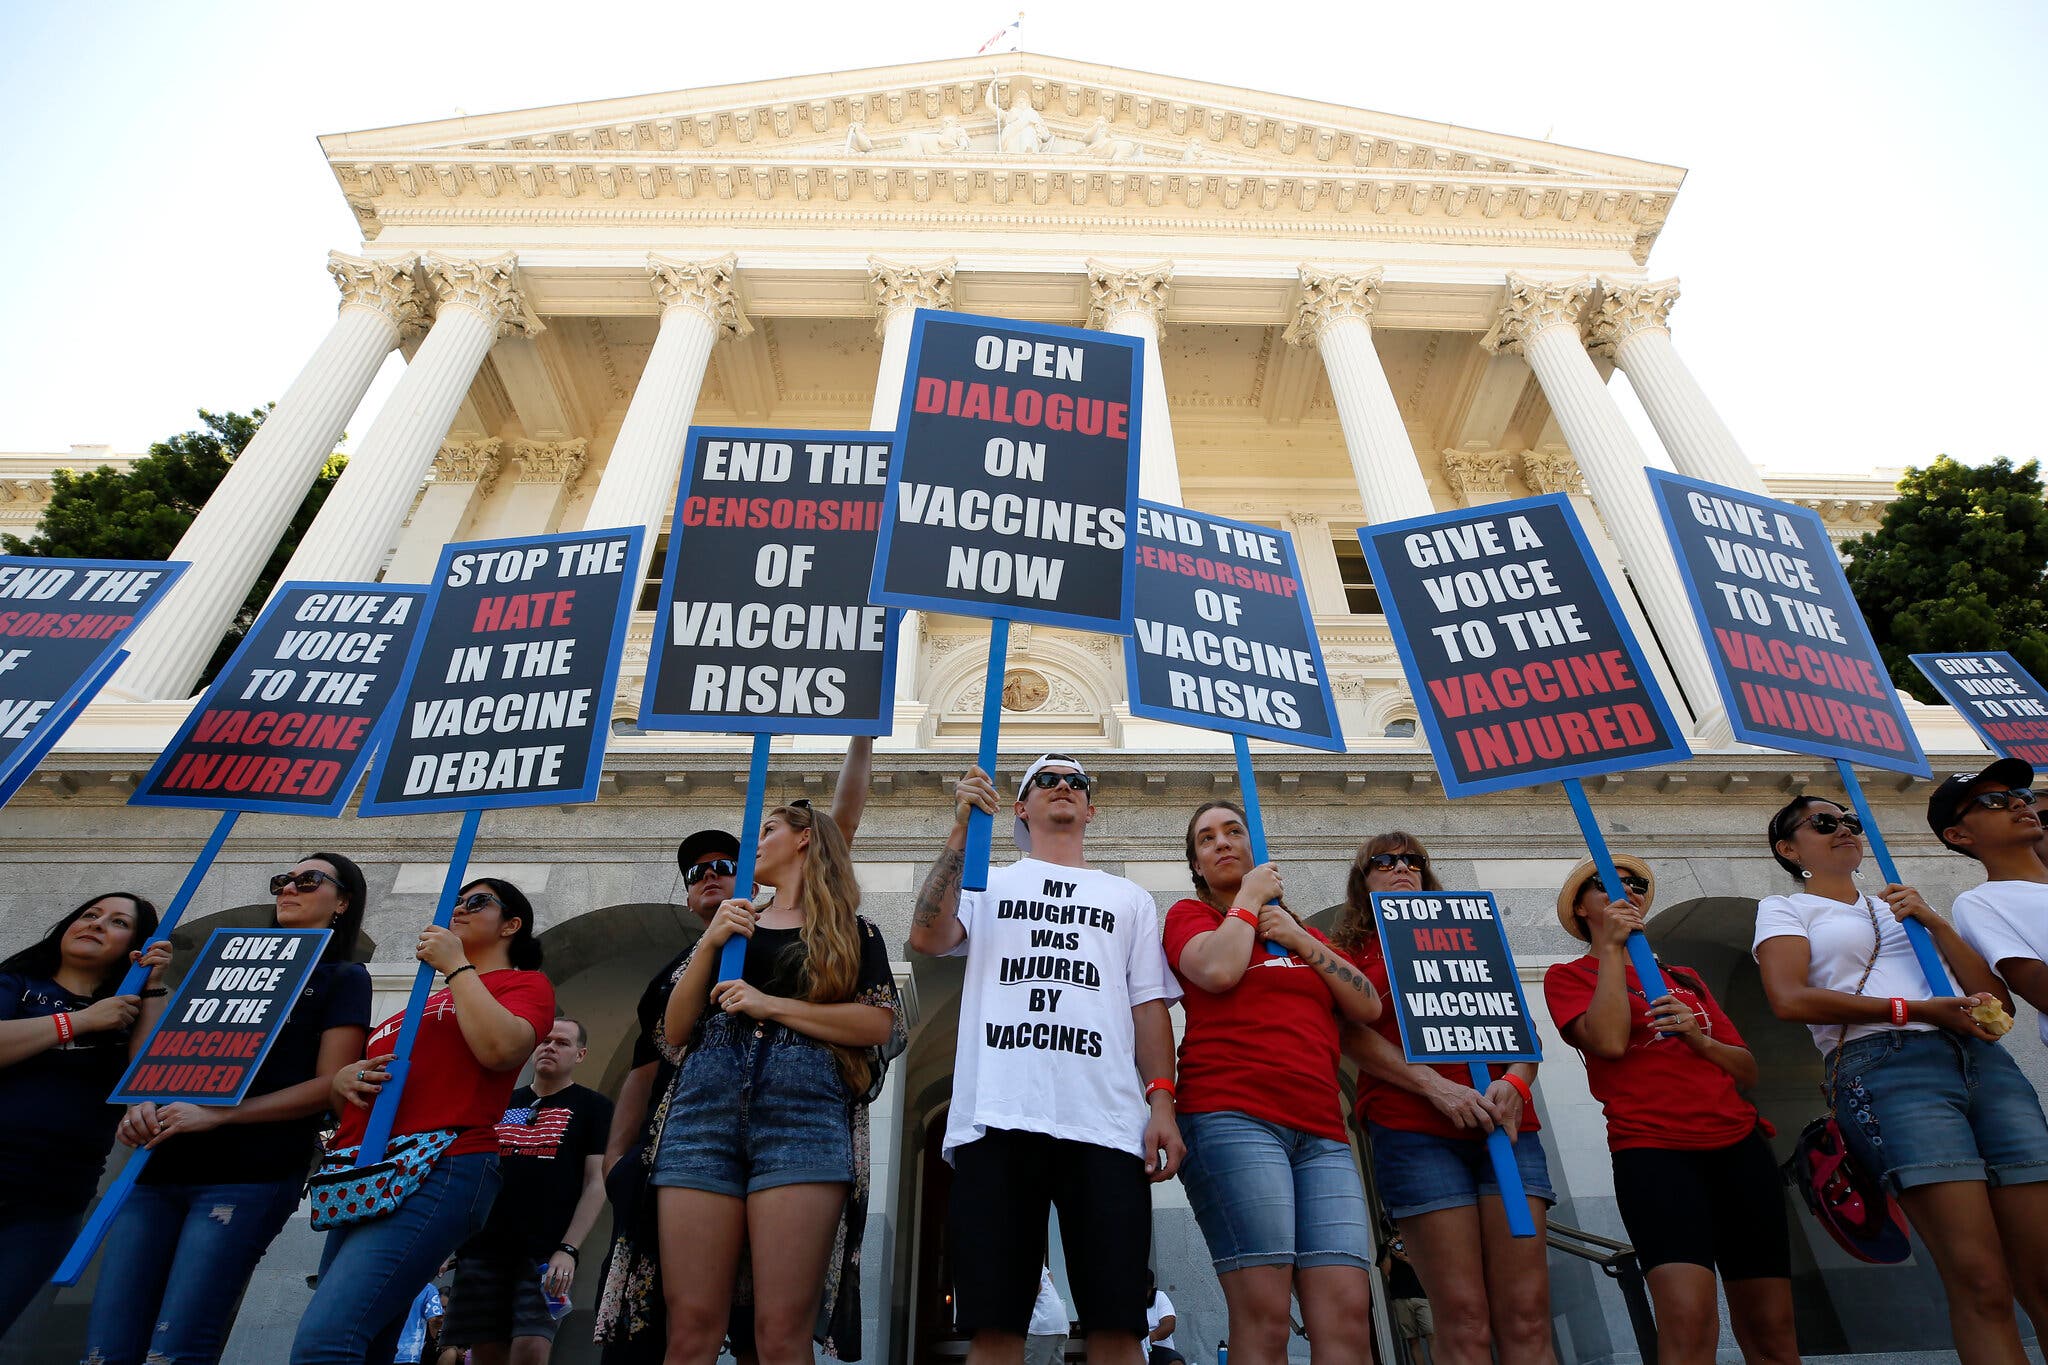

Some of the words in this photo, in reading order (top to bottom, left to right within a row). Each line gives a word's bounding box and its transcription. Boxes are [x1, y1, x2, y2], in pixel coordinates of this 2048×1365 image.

[975, 336, 1083, 382] OPEN
[916, 378, 1128, 439] DIALOGUE
[703, 441, 792, 482] END
[805, 444, 888, 484] THE
[985, 438, 1046, 481] ON
[899, 482, 1125, 549] VACCINES
[1687, 492, 1775, 542] GIVE
[1773, 513, 1804, 550] A
[1136, 508, 1203, 553] END
[1209, 524, 1282, 565] THE
[1405, 521, 1506, 568] GIVE
[1508, 516, 1544, 551] A
[448, 549, 549, 587] STOP
[558, 541, 627, 577] THE
[755, 544, 815, 587] OF
[947, 546, 1064, 600] NOW
[1704, 536, 1821, 595] VOICE
[69, 570, 162, 602] THE
[1422, 559, 1561, 612] VOICE
[0, 612, 132, 638] SORSHIP
[295, 594, 386, 623] GIVE
[379, 597, 413, 624] A
[473, 591, 575, 632] HATE
[673, 602, 885, 651] VACCINE
[1195, 589, 1242, 626] OF
[1715, 581, 1771, 626] TO
[1769, 594, 1848, 645] THE
[274, 631, 393, 663] VOICE
[1134, 618, 1318, 686] VACCINE
[1432, 620, 1496, 662] TO
[1497, 604, 1591, 651] THE
[445, 646, 493, 683] IN
[502, 639, 575, 679] THE
[1716, 629, 1884, 698] VACCINE
[1935, 658, 1990, 674] GIVE
[1984, 658, 2008, 673] A
[240, 669, 296, 700] TO
[297, 671, 377, 705] THE
[690, 665, 845, 715] RISKS
[1169, 670, 1301, 729] RISKS
[1429, 650, 1636, 718] VACCINE
[1954, 678, 2027, 695] VOICE
[411, 689, 592, 738] VACCINE
[1742, 682, 1904, 750] INJURED
[1970, 700, 2008, 717] TO
[2001, 699, 2048, 716] THE
[193, 711, 370, 750] VACCINE
[1456, 703, 1656, 772] INJURED
[164, 754, 340, 796] INJURED
[403, 745, 565, 795] DEBATE
[1043, 880, 1076, 897] MY
[998, 900, 1114, 933] DAUGHTER
[1381, 899, 1442, 920] STOP
[1446, 899, 1493, 919] THE
[221, 937, 283, 960] GIVE
[277, 938, 301, 960] A
[1032, 930, 1079, 950] WAS
[1414, 928, 1477, 951] HATE
[206, 967, 285, 991] VOICE
[1000, 956, 1100, 987] INJURED
[1413, 960, 1441, 982] IN
[1443, 960, 1492, 982] THE
[182, 999, 220, 1023] TO
[219, 999, 272, 1023] THE
[1029, 989, 1061, 1012] BY
[1406, 992, 1518, 1016] VACCINE
[149, 1031, 265, 1057] VACCINE
[987, 1023, 1101, 1057] VACCINES
[1422, 1027, 1519, 1051] DEBATE
[129, 1065, 243, 1092] INJURED
